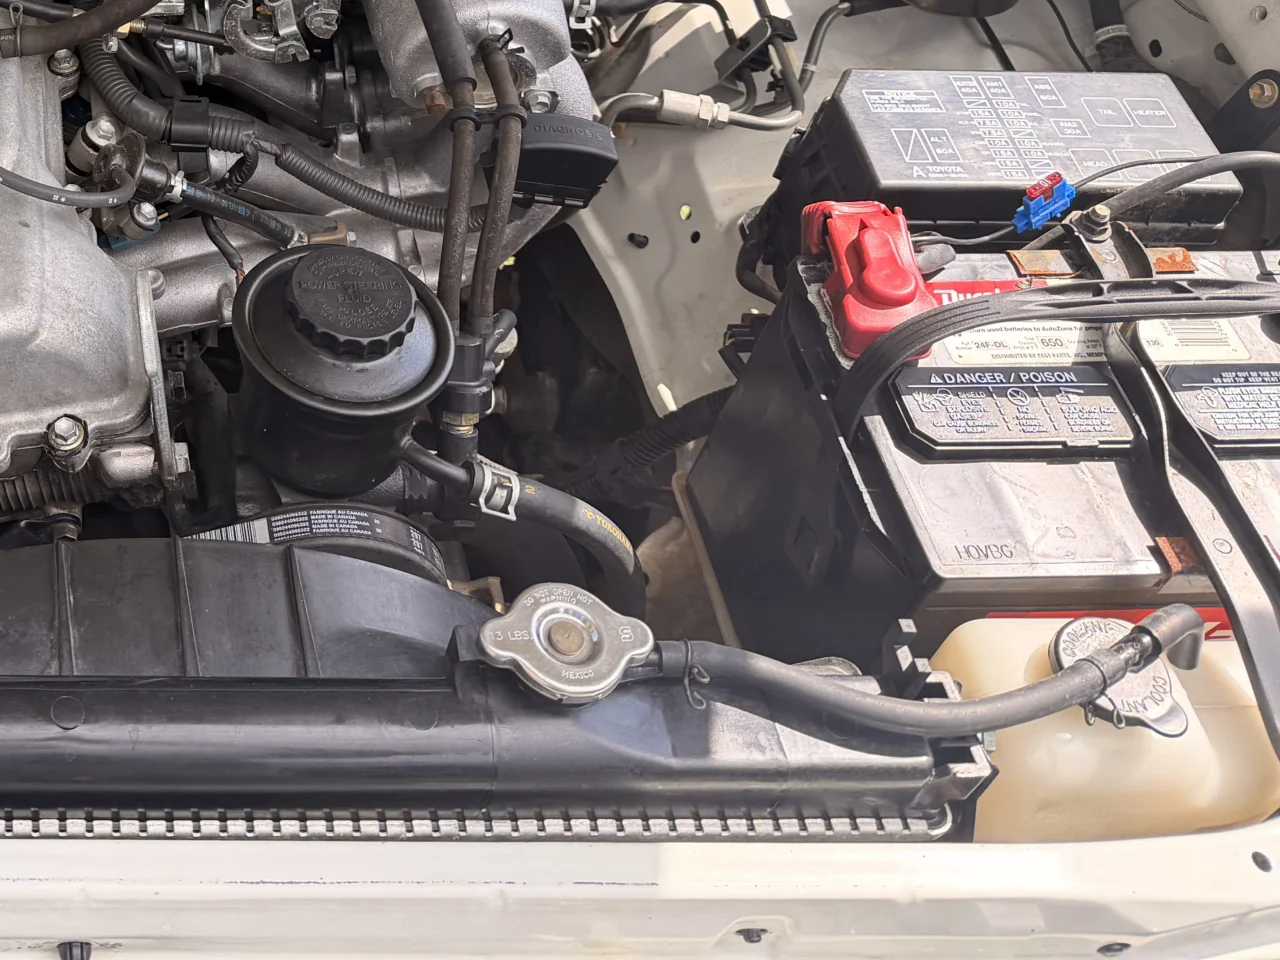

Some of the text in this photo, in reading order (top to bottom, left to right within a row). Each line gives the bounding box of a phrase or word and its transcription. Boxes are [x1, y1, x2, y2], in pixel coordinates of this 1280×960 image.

[533, 125, 603, 141] DIAGNOSIS
[912, 165, 927, 177] A
[300, 280, 405, 291] POWER STEERING
[337, 294, 372, 303] FLUID
[1040, 338, 1063, 347] 650
[943, 372, 1005, 384] DANGER
[1019, 372, 1077, 383] POISON
[524, 588, 594, 607] DO NOT OPEN HOT
[540, 595, 577, 605] WARNING
[489, 630, 534, 640] 13 LBS.
[1062, 620, 1116, 658] COOLANT
[561, 669, 594, 679] MEXICO
[1119, 675, 1170, 713] COOLANT
